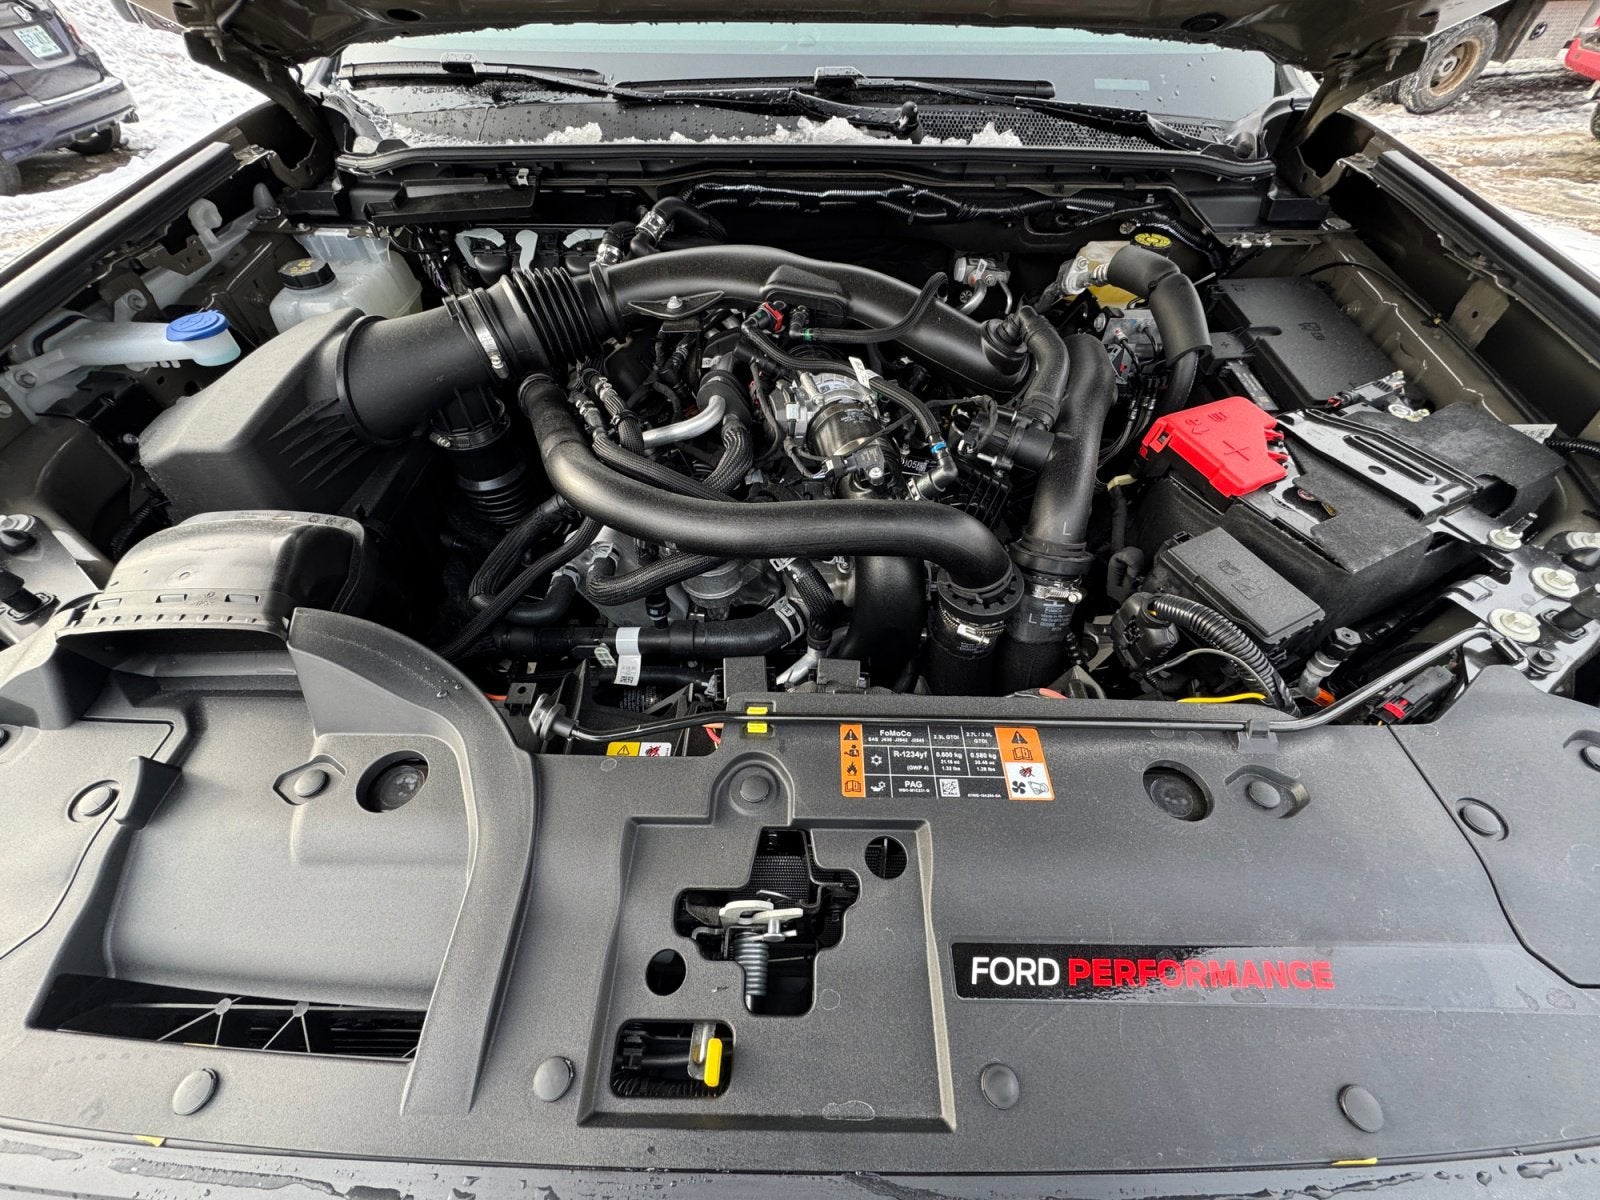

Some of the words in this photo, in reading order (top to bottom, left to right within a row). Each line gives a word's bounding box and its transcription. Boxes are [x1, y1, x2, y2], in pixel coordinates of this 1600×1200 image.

[879, 729, 912, 737] FoMoCo
[893, 750, 928, 760] R-1234yf
[953, 751, 963, 760] kg
[988, 752, 997, 760] kg
[904, 780, 923, 788] PAG
[971, 956, 1060, 986] FORD
[1067, 957, 1336, 991] PERFORMANCE
